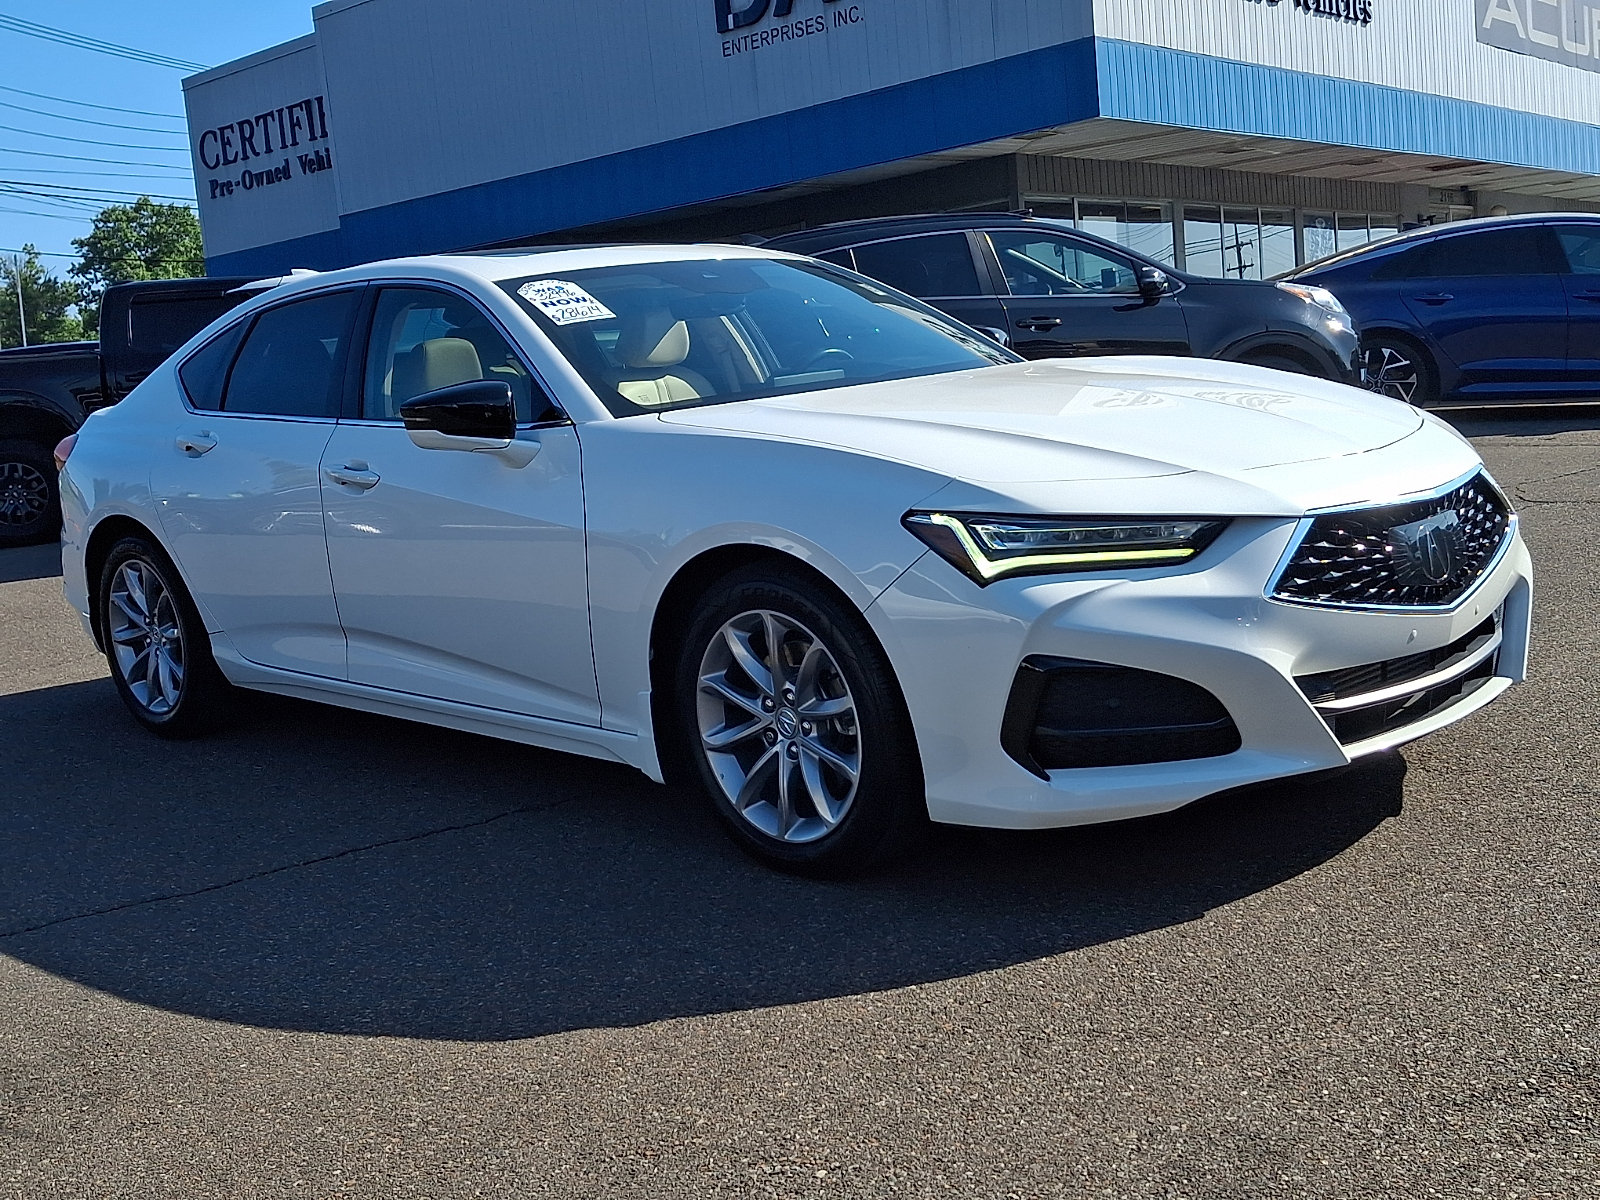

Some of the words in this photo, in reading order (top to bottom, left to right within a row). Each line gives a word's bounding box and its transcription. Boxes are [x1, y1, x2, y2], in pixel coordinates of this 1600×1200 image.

[721, 15, 829, 58] ENTERPRISES,
[833, 5, 864, 28] INC.
[209, 158, 292, 199] Pre-Owned
[540, 296, 588, 308] NOW
